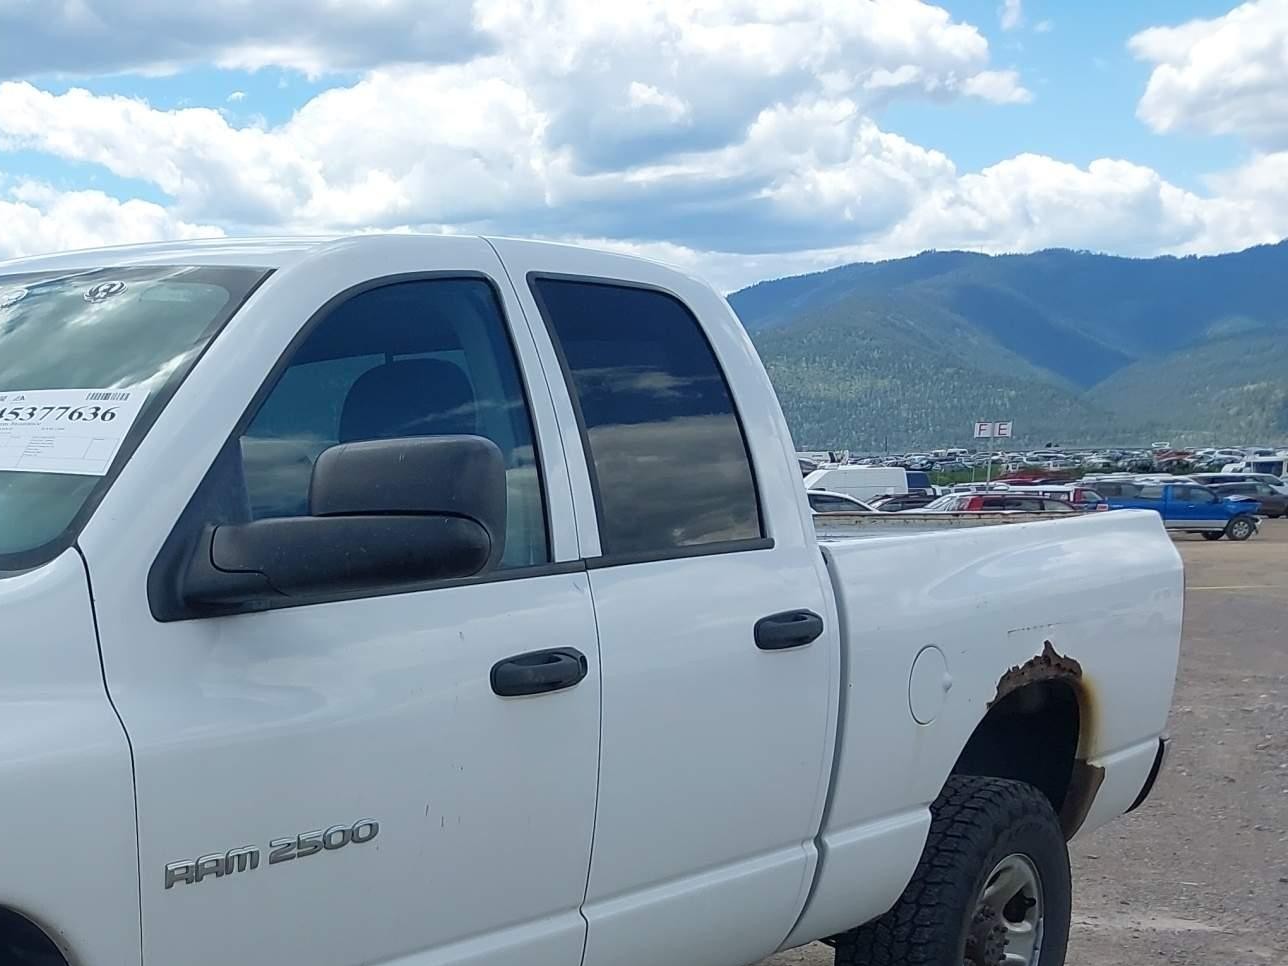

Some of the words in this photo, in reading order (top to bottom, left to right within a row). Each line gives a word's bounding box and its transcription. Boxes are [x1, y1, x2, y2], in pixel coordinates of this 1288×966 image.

[978, 423, 988, 436] F
[998, 423, 1008, 436] E
[164, 845, 260, 889] RAM
[269, 818, 380, 865] 2500
